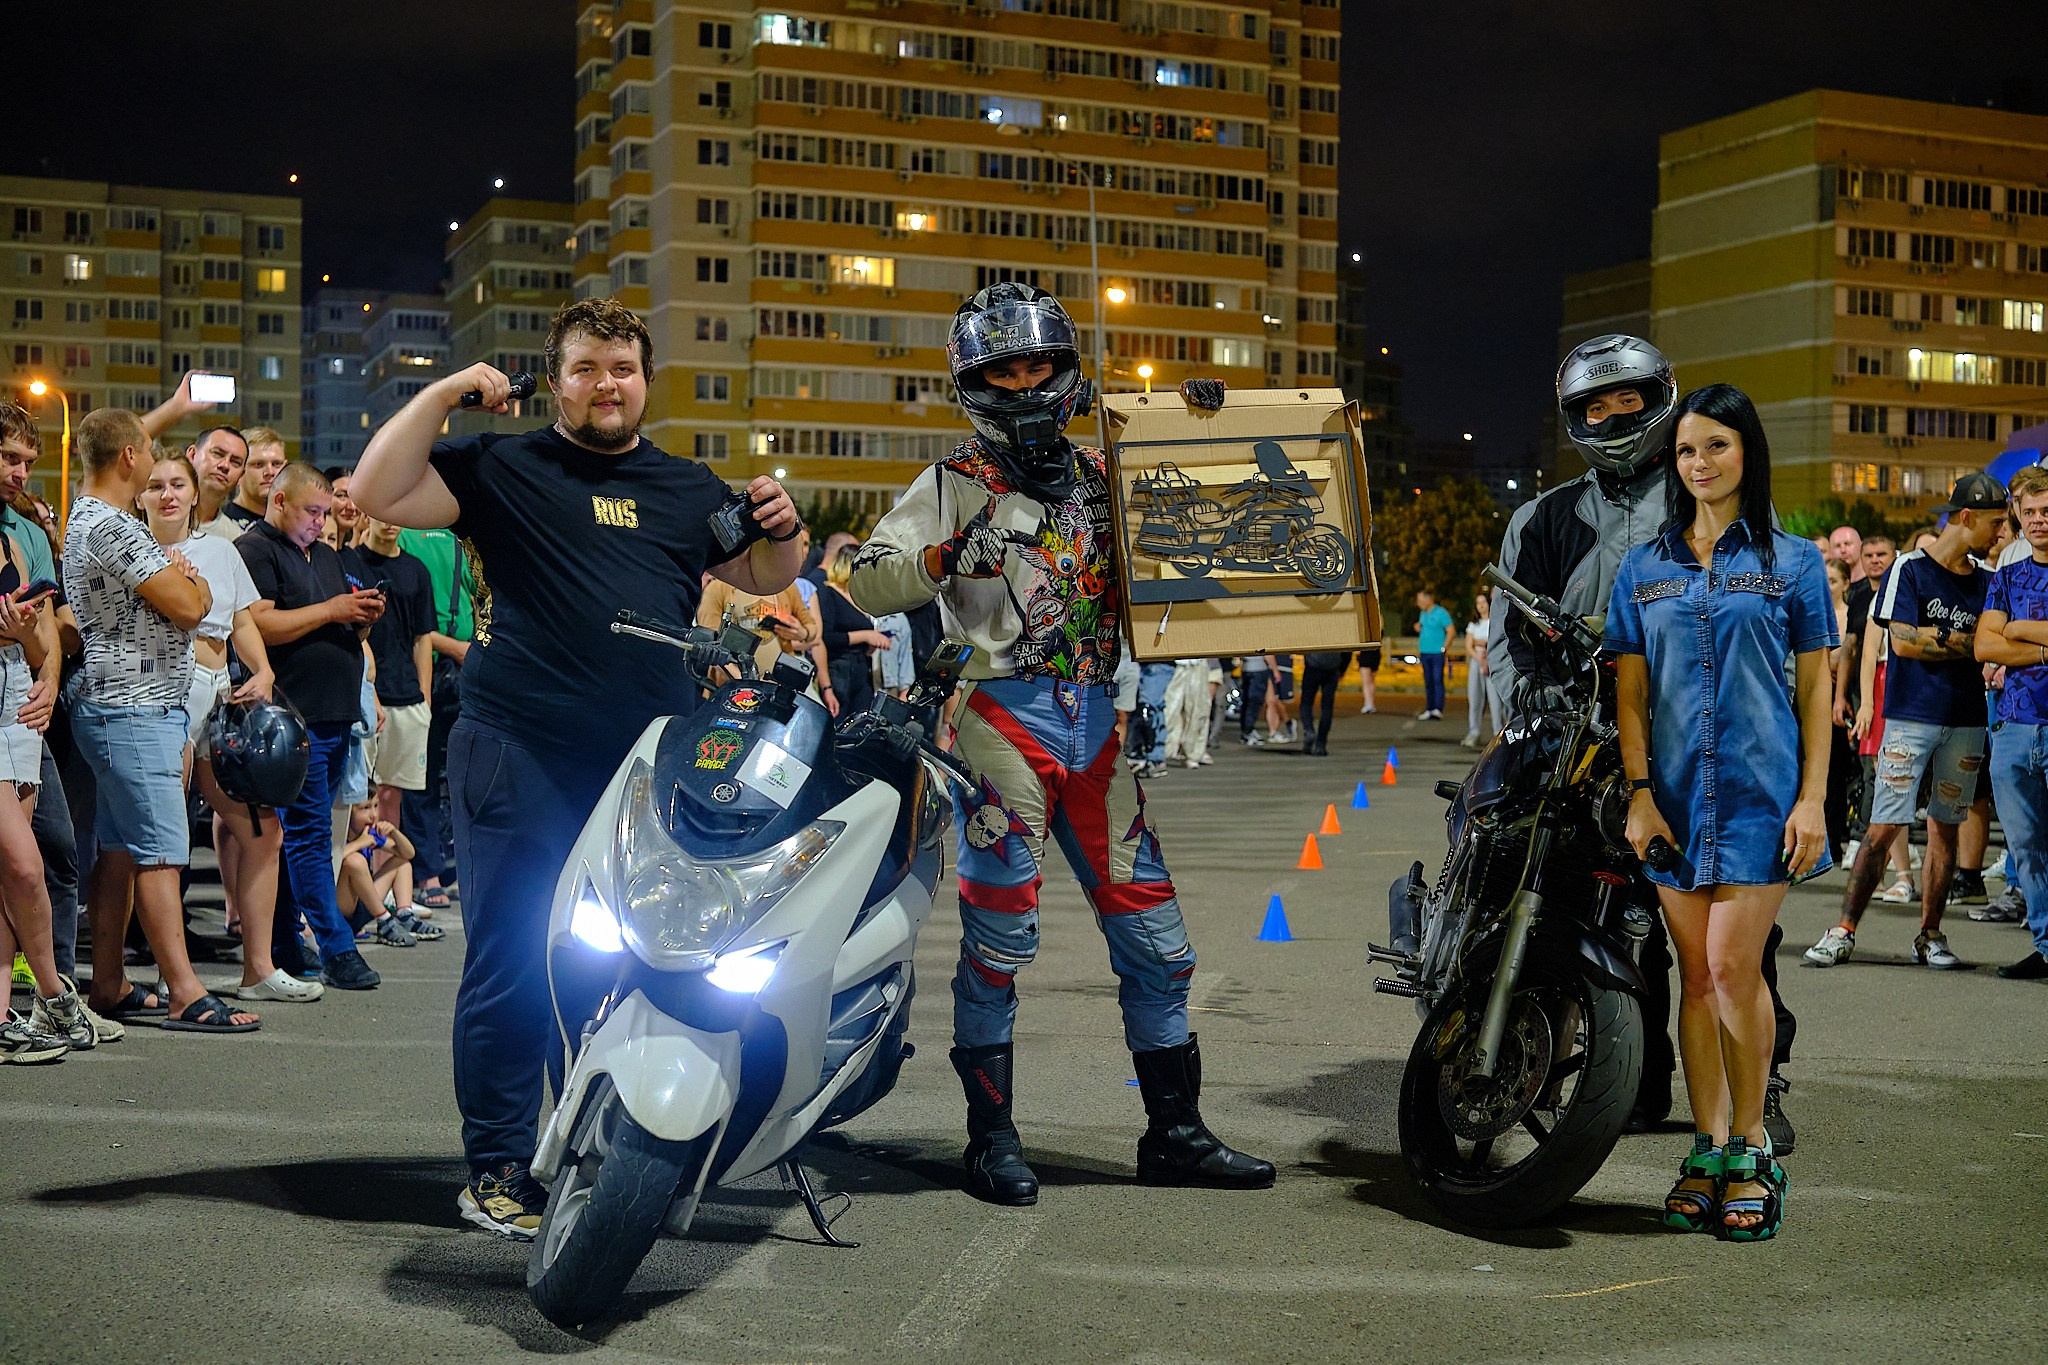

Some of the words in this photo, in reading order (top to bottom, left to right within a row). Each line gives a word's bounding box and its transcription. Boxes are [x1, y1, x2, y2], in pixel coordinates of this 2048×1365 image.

[993, 337, 1037, 351] SHARK
[1588, 362, 1618, 378] SHOEI
[592, 496, 639, 528] RUS
[1926, 597, 1949, 619] Bee
[695, 758, 727, 770] GARAGE
[975, 1068, 1005, 1104] DUCATI
